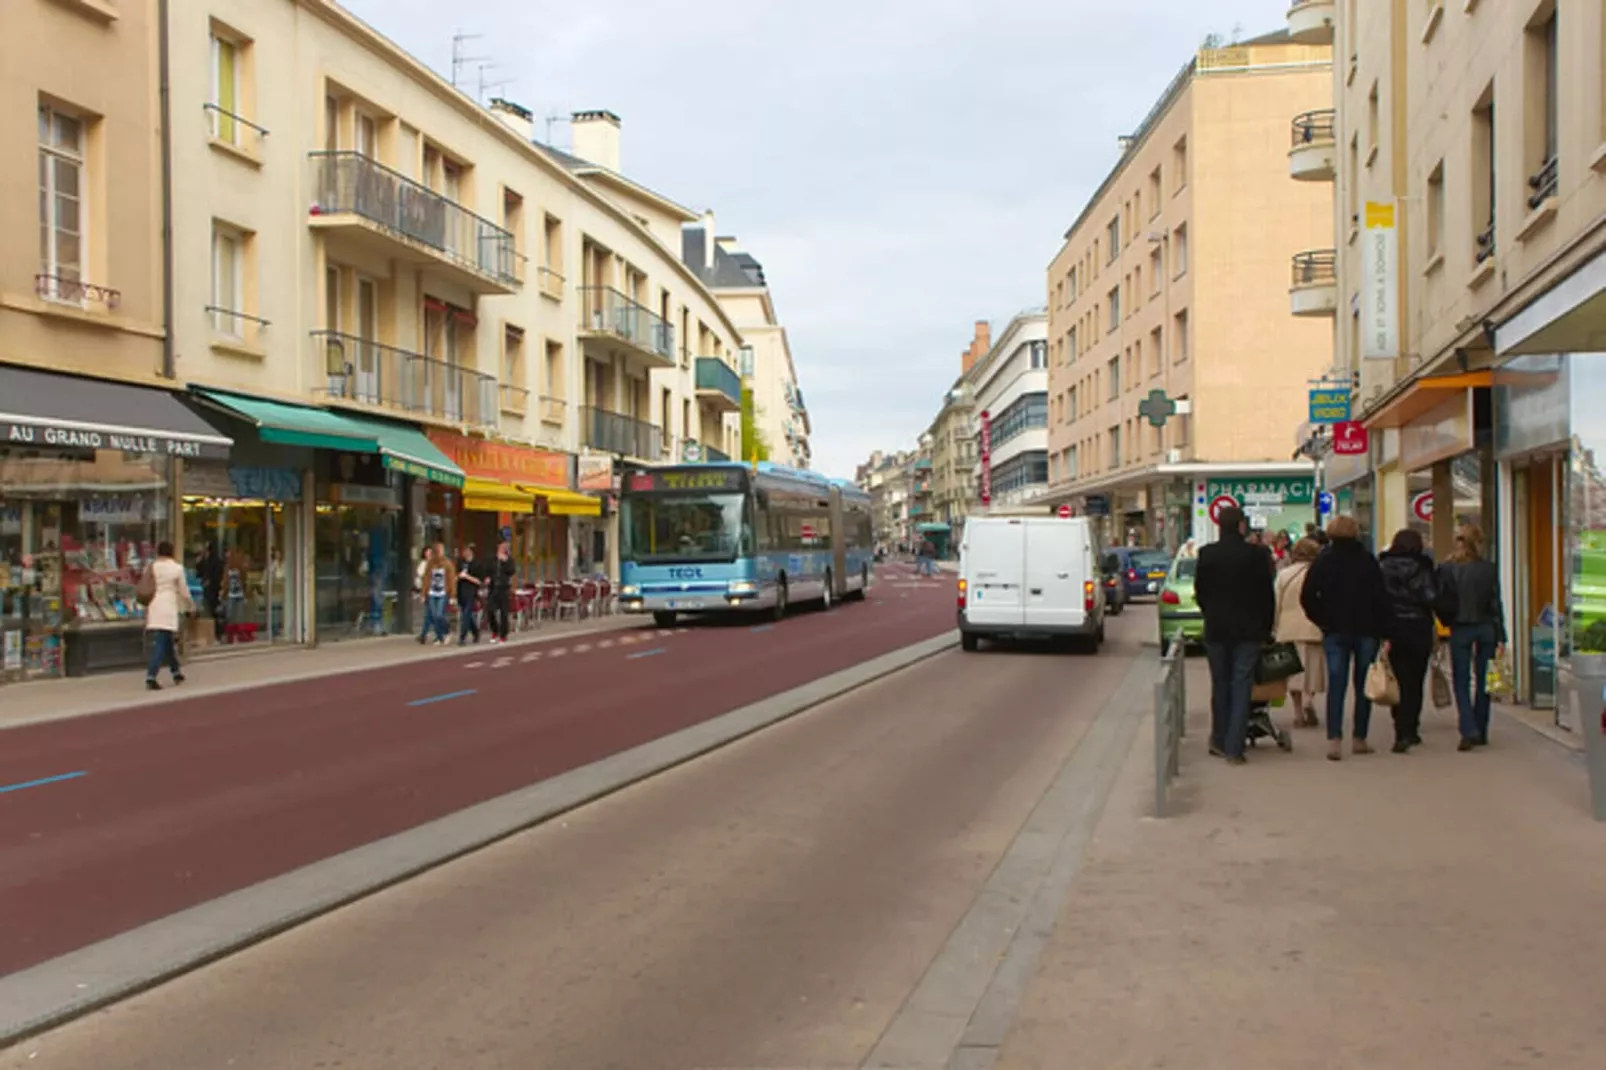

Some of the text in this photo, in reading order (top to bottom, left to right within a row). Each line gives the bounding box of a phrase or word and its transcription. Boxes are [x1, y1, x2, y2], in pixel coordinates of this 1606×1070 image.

[9, 425, 202, 456] AU GRAND NULLE PART
[1208, 482, 1312, 497] PHARMACI
